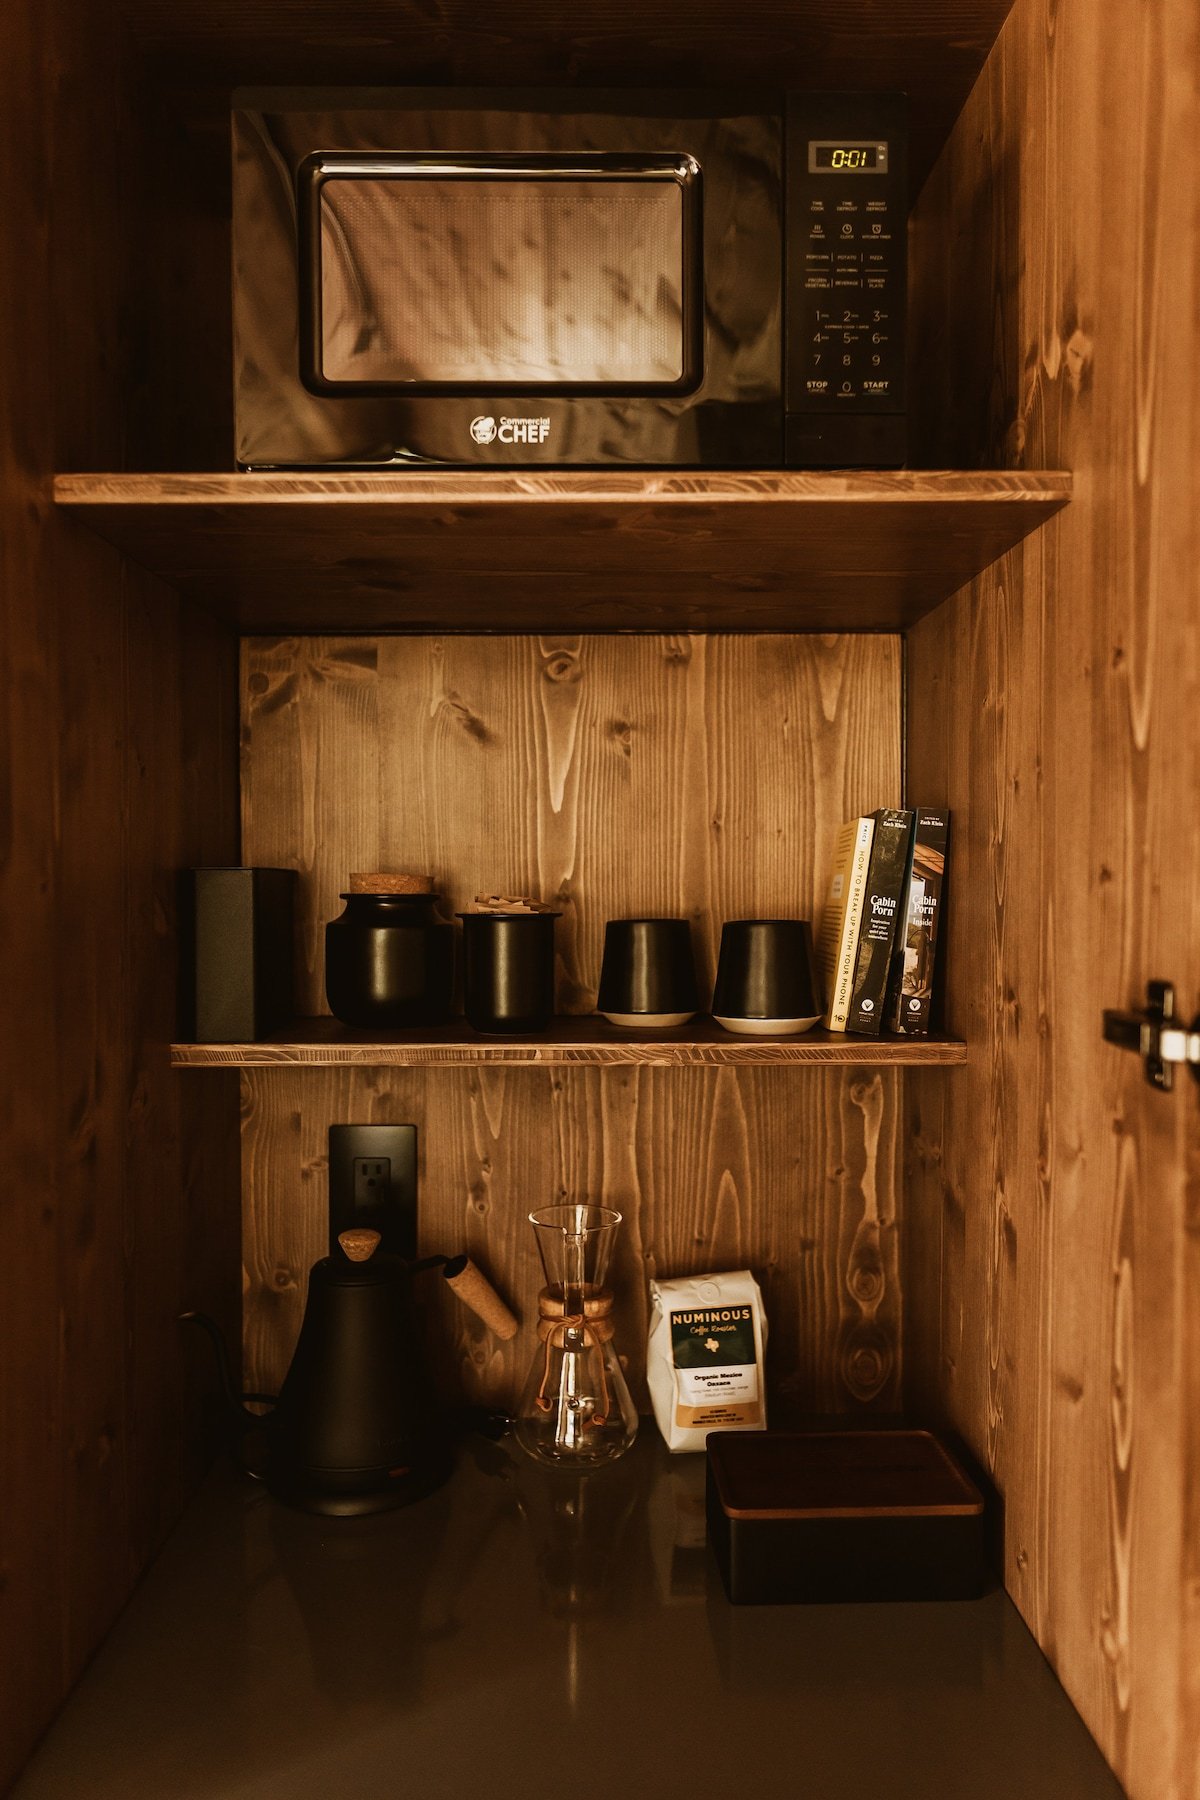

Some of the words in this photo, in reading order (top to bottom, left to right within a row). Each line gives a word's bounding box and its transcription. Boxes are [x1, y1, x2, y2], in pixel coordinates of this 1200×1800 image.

[831, 149, 867, 168] 0:01
[815, 310, 820, 321] 1
[843, 310, 851, 322] 2
[873, 310, 880, 322] 3
[813, 332, 821, 343] 4
[843, 332, 851, 344] 5
[872, 332, 880, 344] 6
[813, 354, 821, 366] 7
[842, 354, 851, 366] 8
[872, 354, 881, 366] 9
[806, 381, 828, 389] STOP
[842, 381, 852, 393] 0
[863, 381, 889, 389] START
[499, 416, 551, 425] Commercial
[497, 424, 551, 443] CHEF
[894, 821, 907, 829] Klein
[855, 874, 862, 885] TO
[852, 887, 860, 913] BREAK
[870, 894, 897, 908] Cabin
[912, 894, 937, 906] Cabin
[872, 904, 894, 917] Porn
[913, 903, 934, 915] Porn
[850, 917, 856, 927] UP
[912, 917, 933, 927] Inside
[843, 953, 851, 975] YOUR
[838, 978, 847, 1005] PHONE
[672, 1309, 750, 1325] NUMINOUS
[690, 1325, 709, 1336] Coffee
